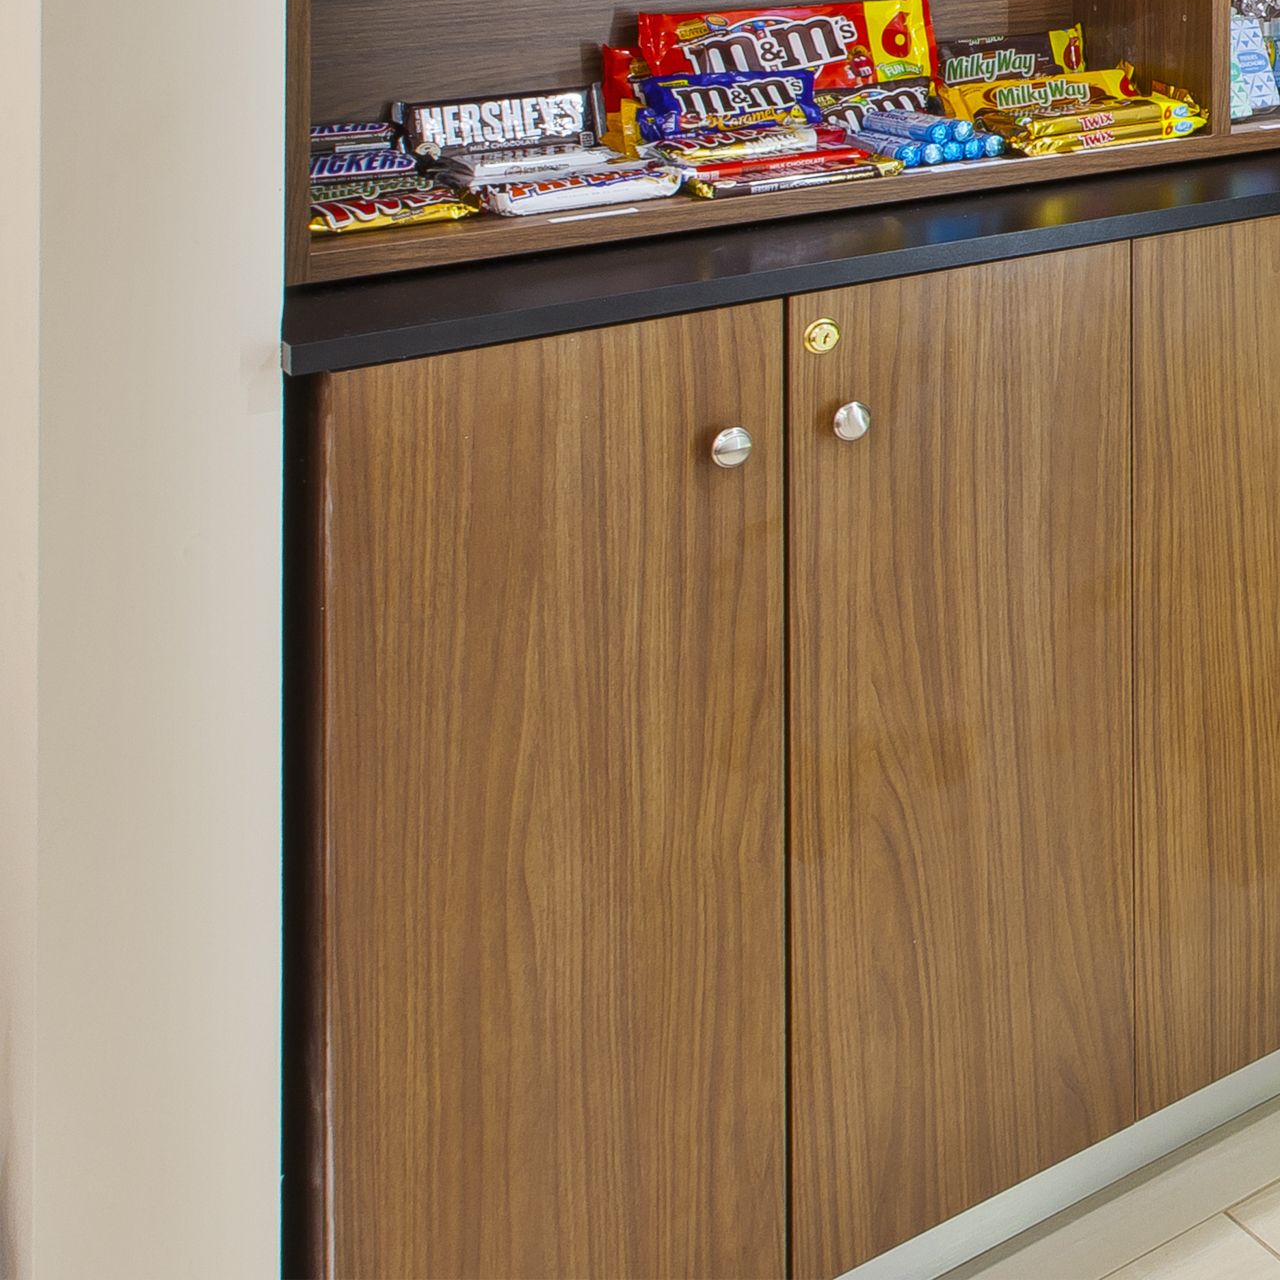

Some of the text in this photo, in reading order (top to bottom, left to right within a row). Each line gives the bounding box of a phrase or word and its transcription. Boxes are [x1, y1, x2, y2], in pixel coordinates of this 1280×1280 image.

[681, 15, 857, 73] m&m's
[882, 11, 911, 58] 6
[996, 79, 1090, 110] Milky Way
[418, 95, 584, 146] HERSHEY'S
[492, 138, 539, 149] CHOCOLATE
